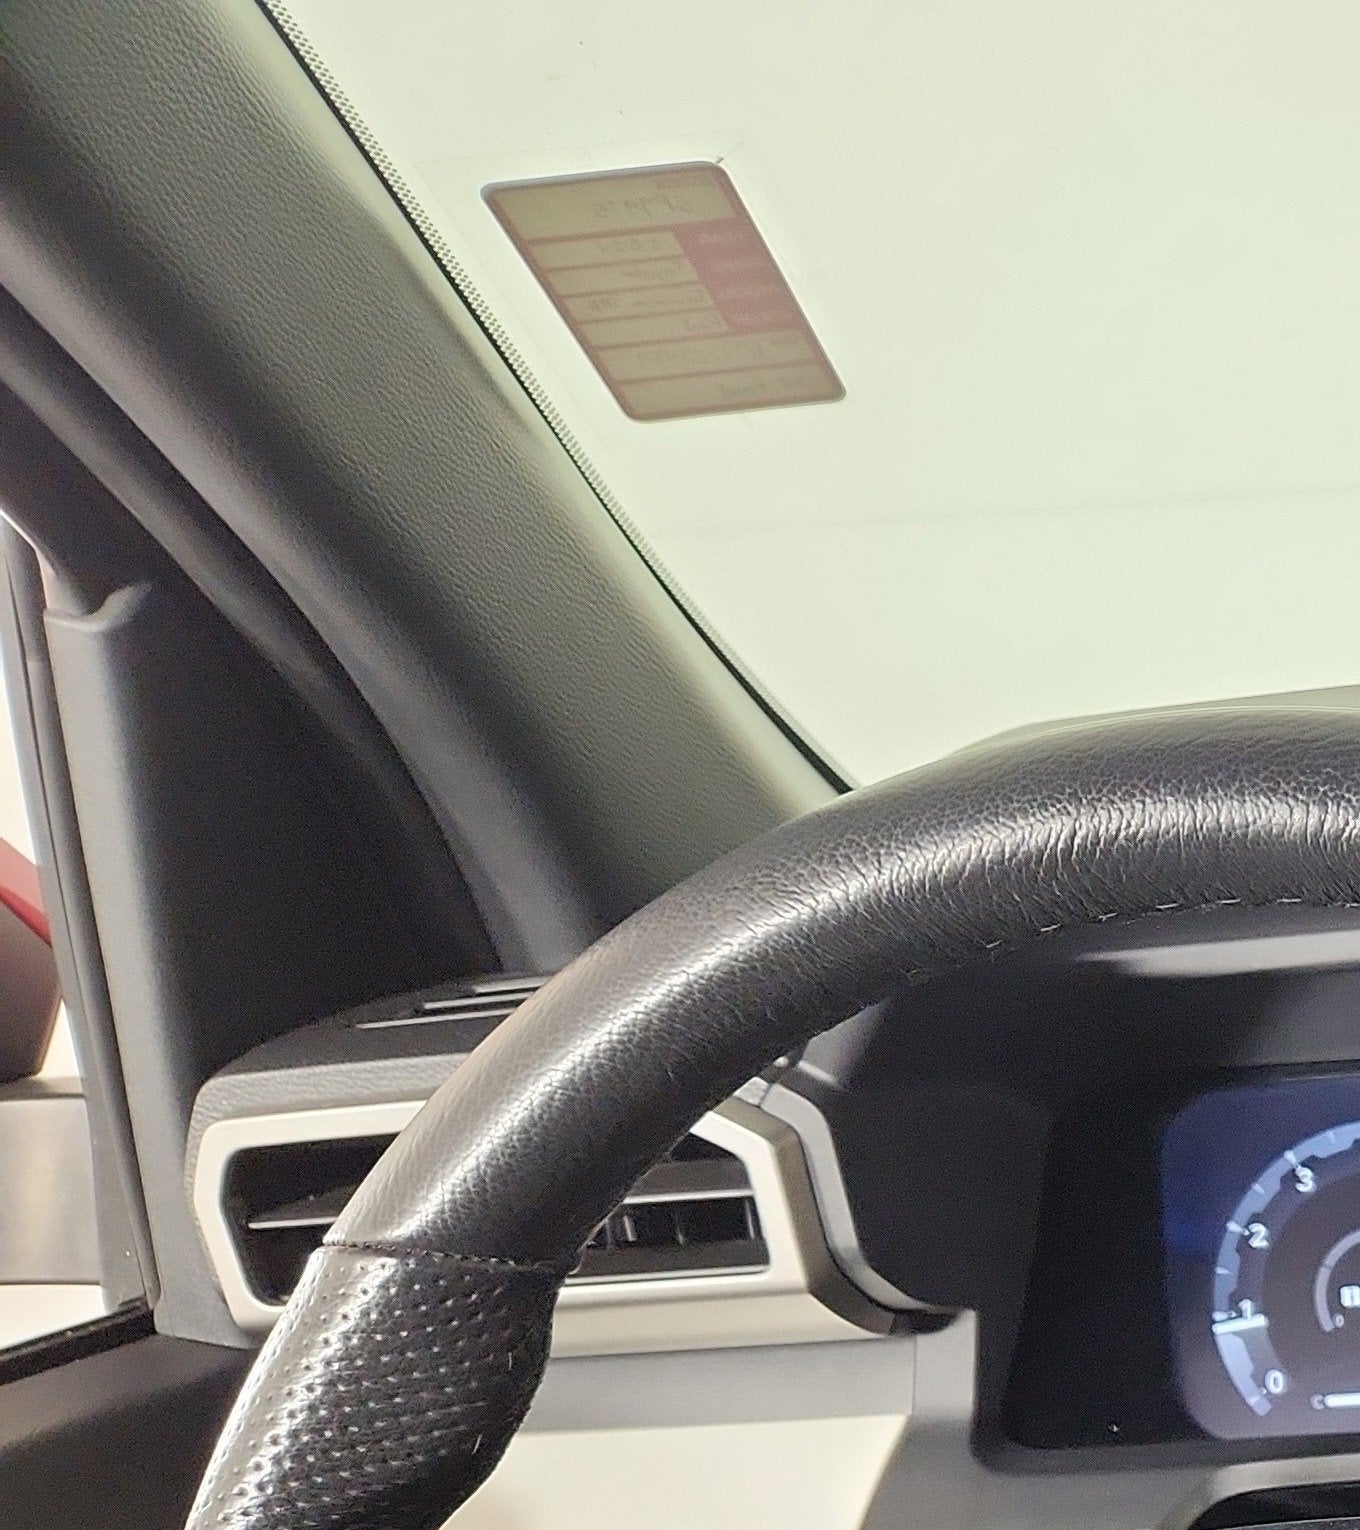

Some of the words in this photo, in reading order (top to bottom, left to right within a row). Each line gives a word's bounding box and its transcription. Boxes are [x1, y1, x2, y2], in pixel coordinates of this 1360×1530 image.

[1295, 1166, 1316, 1193] 3
[1248, 1223, 1269, 1249] 2
[1264, 1370, 1286, 1395] 0
